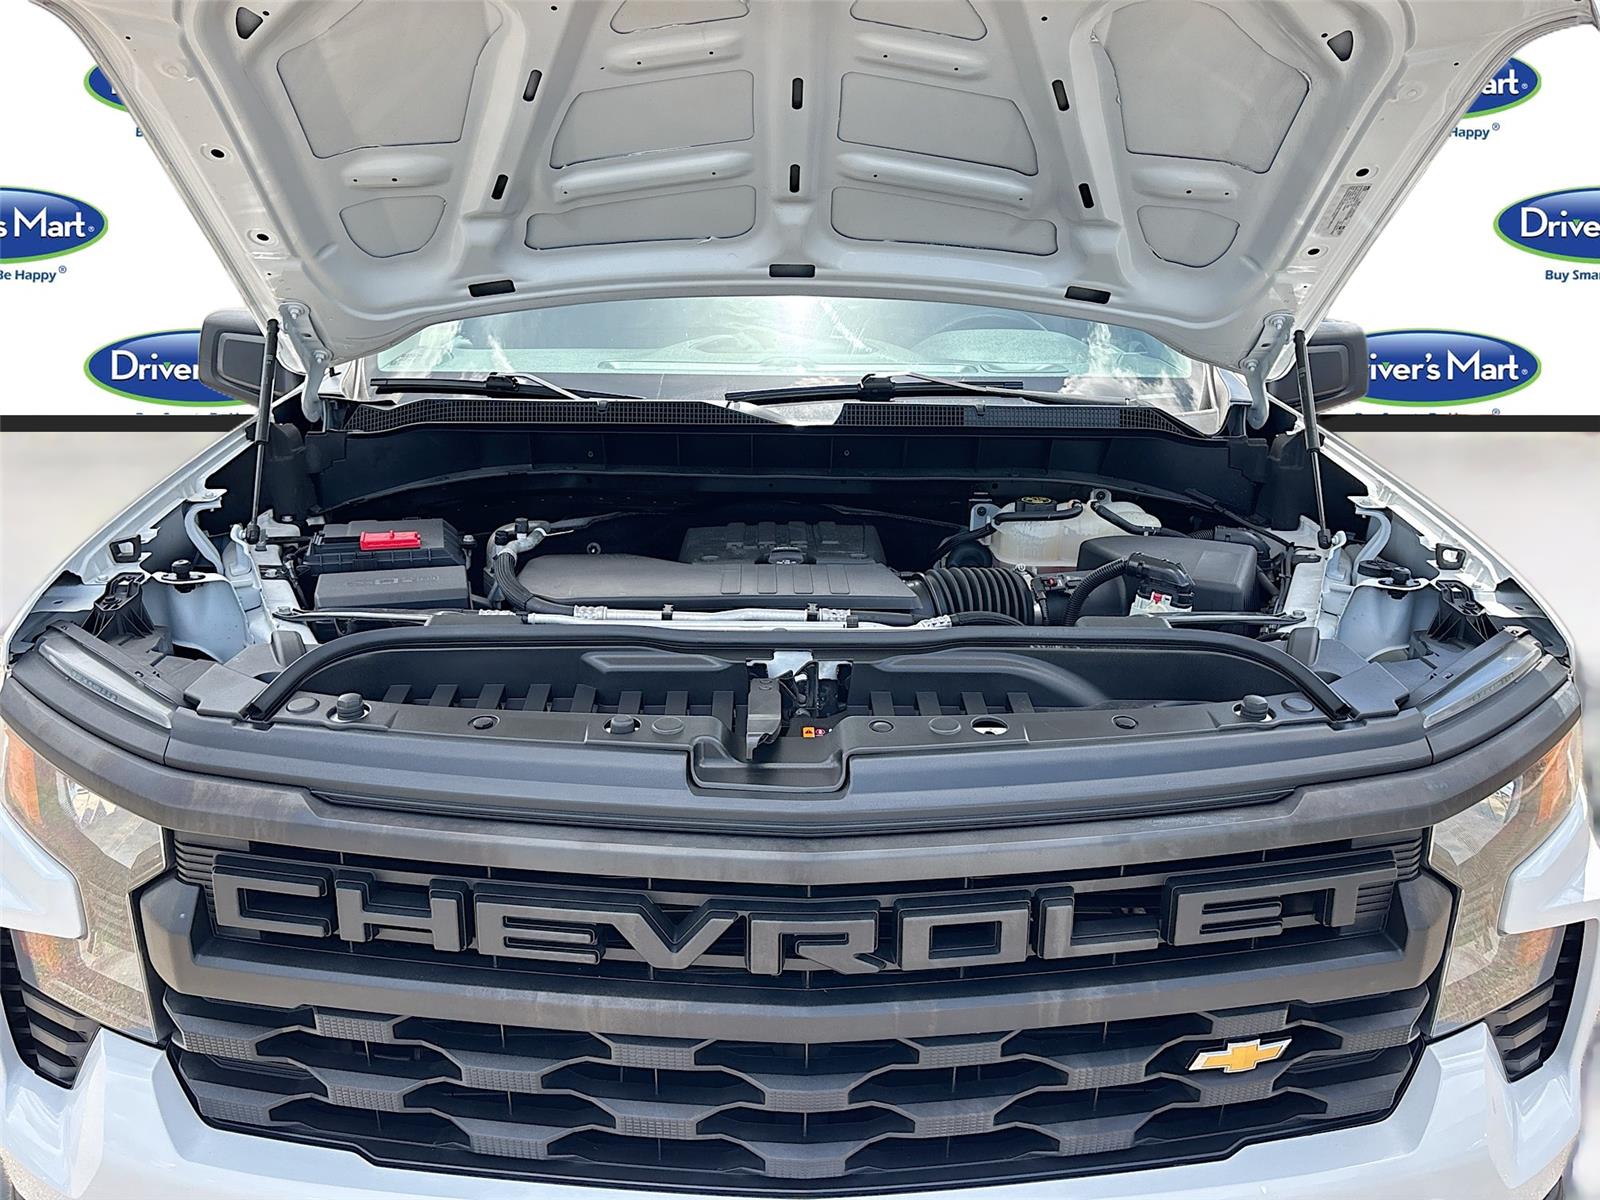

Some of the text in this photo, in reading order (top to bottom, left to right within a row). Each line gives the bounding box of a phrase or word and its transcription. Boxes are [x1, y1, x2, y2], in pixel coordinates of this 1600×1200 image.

[1481, 68, 1519, 95] art
[1450, 127, 1490, 140] Happy
[14, 206, 86, 238] Mart
[15, 269, 57, 283] Happy
[1545, 269, 1570, 283] Buy
[1368, 349, 1519, 381] iver's Mart
[211, 850, 1398, 976] CHEVROLET
